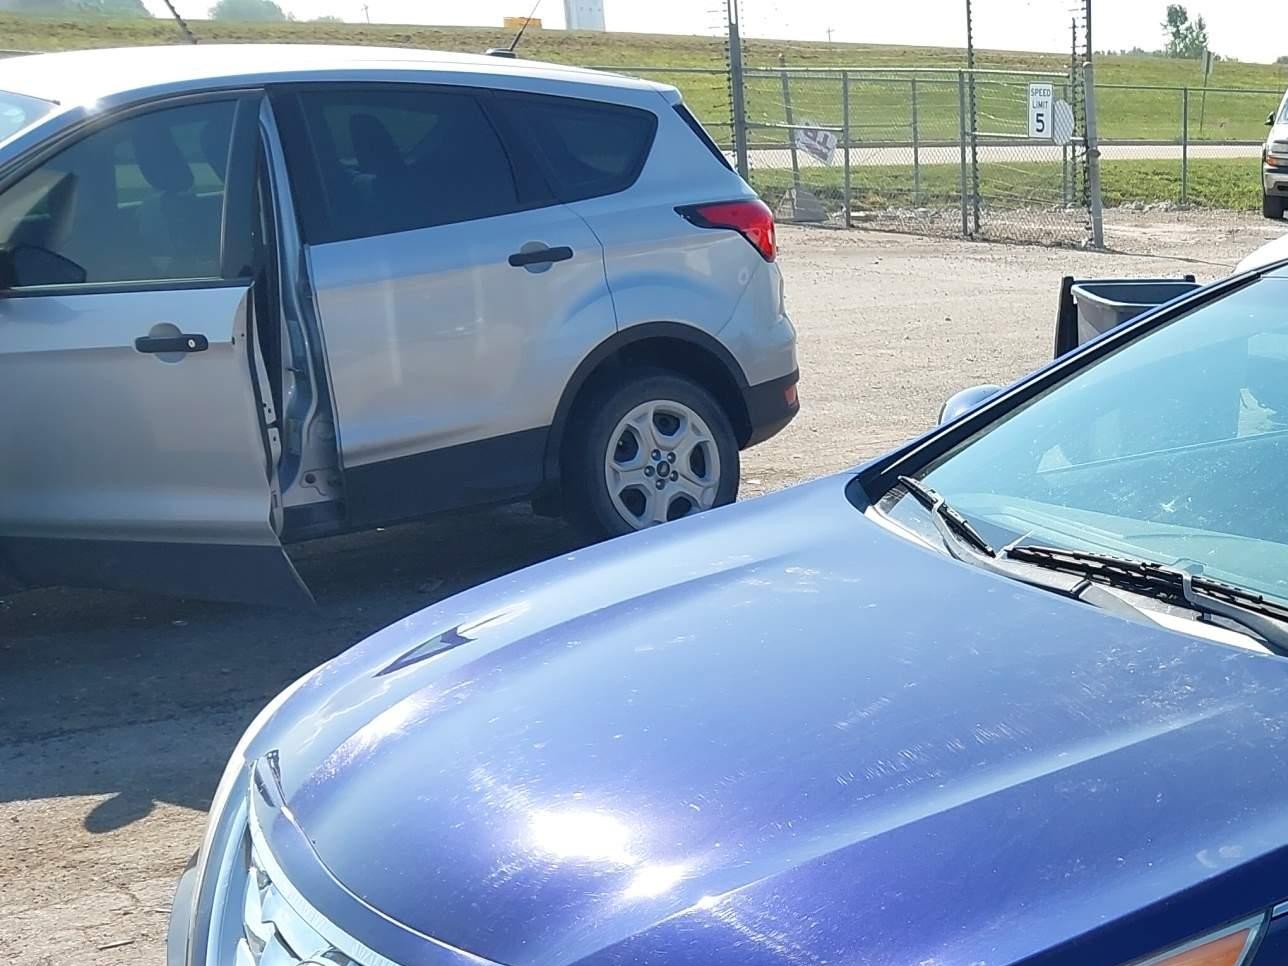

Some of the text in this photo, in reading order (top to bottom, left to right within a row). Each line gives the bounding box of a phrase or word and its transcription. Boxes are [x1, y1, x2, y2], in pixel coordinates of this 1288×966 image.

[1031, 88, 1051, 97] SPEED
[1032, 101, 1049, 109] LIMIT
[1036, 113, 1045, 133] 5
